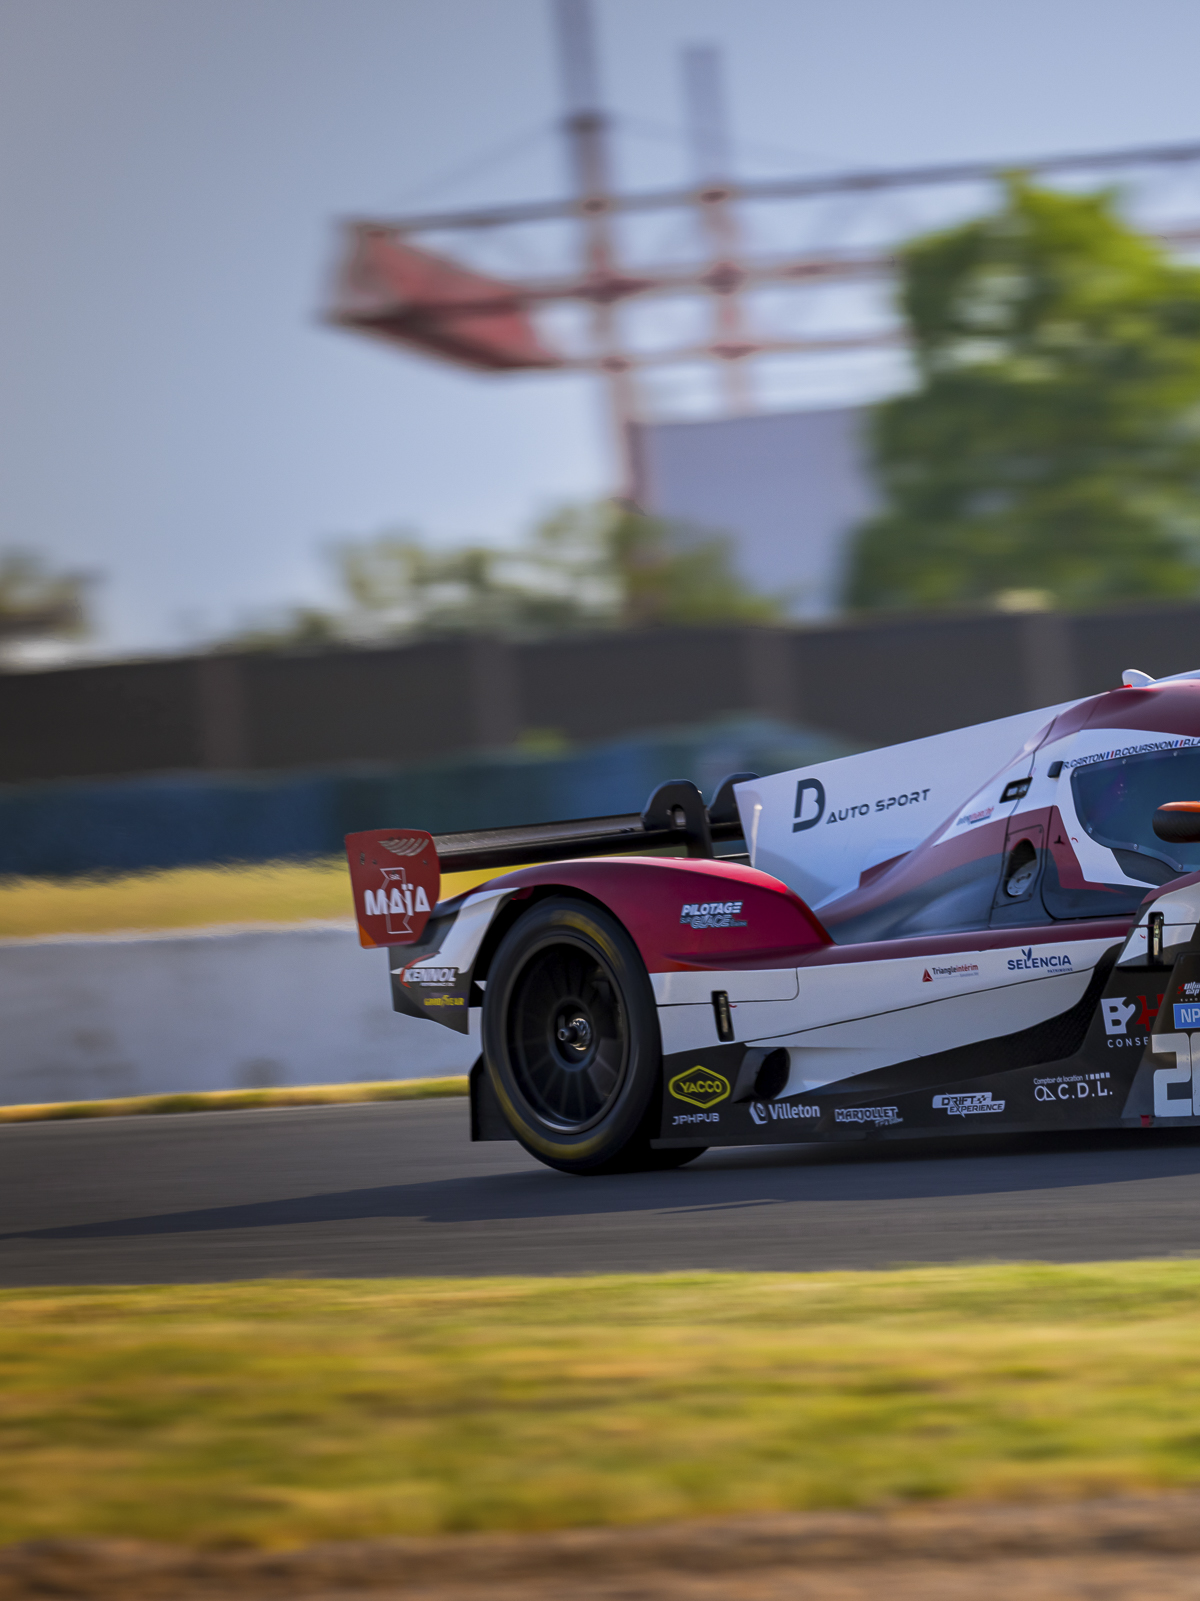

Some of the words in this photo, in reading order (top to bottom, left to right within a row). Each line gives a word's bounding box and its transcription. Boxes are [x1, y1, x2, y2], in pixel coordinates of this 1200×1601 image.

[826, 803, 870, 825] AUTO
[875, 788, 931, 812] SPORT
[364, 884, 431, 916] MAÏA
[681, 901, 743, 916] PILOTAGE
[1007, 955, 1072, 971] SELENCIA
[403, 968, 457, 982] KENNOL
[679, 1080, 722, 1093] YACCO
[941, 1096, 977, 1106] DRIFT
[949, 1103, 1003, 1113] EXPERIENCE
[672, 1112, 720, 1125] JPHPUB
[768, 1103, 821, 1120] Villeton
[835, 1107, 898, 1122] MARJOLLET
